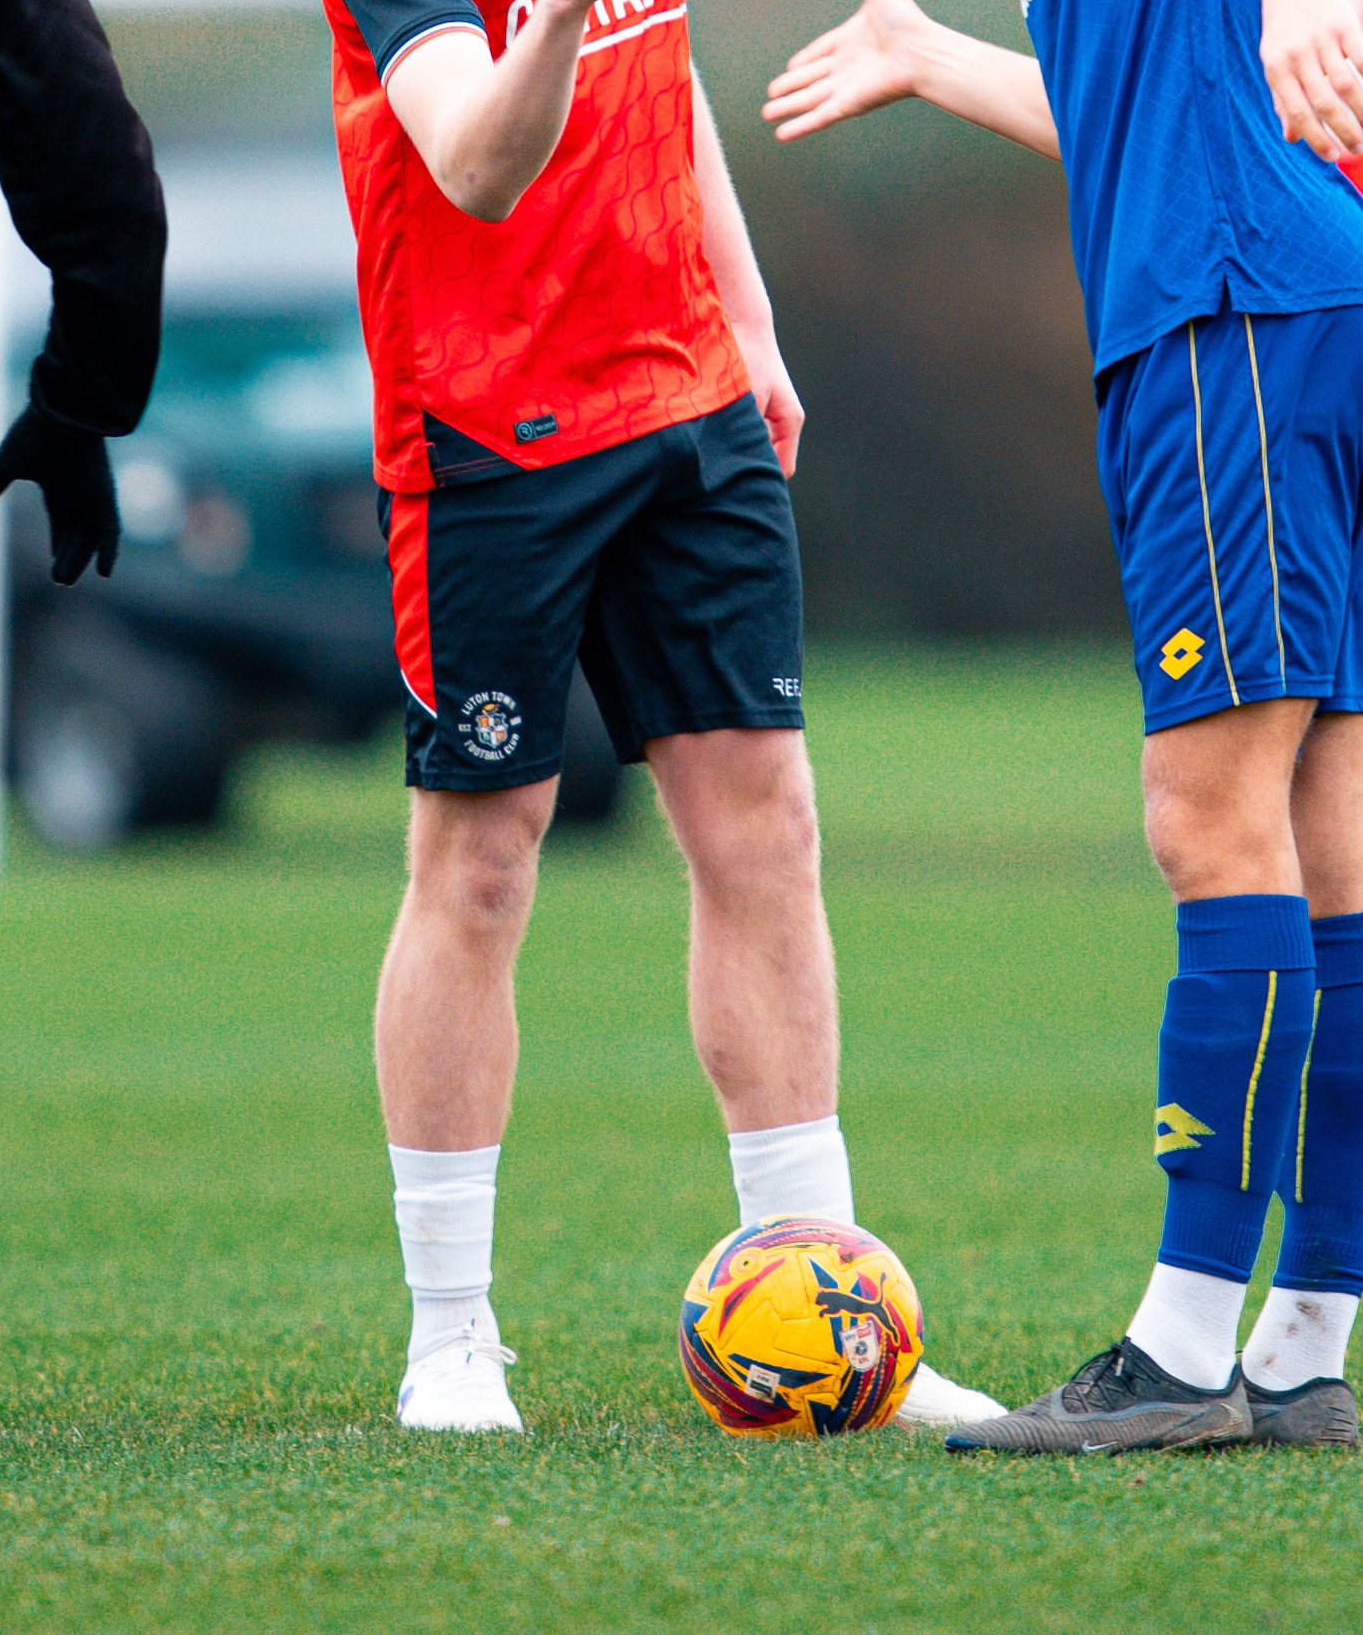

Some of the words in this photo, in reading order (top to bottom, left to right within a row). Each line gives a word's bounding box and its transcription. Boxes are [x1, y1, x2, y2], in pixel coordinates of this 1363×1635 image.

[772, 678, 802, 697] REF
[461, 691, 489, 715] LUTON
[492, 691, 516, 710] TOWN
[464, 739, 505, 760] FOOTBALL
